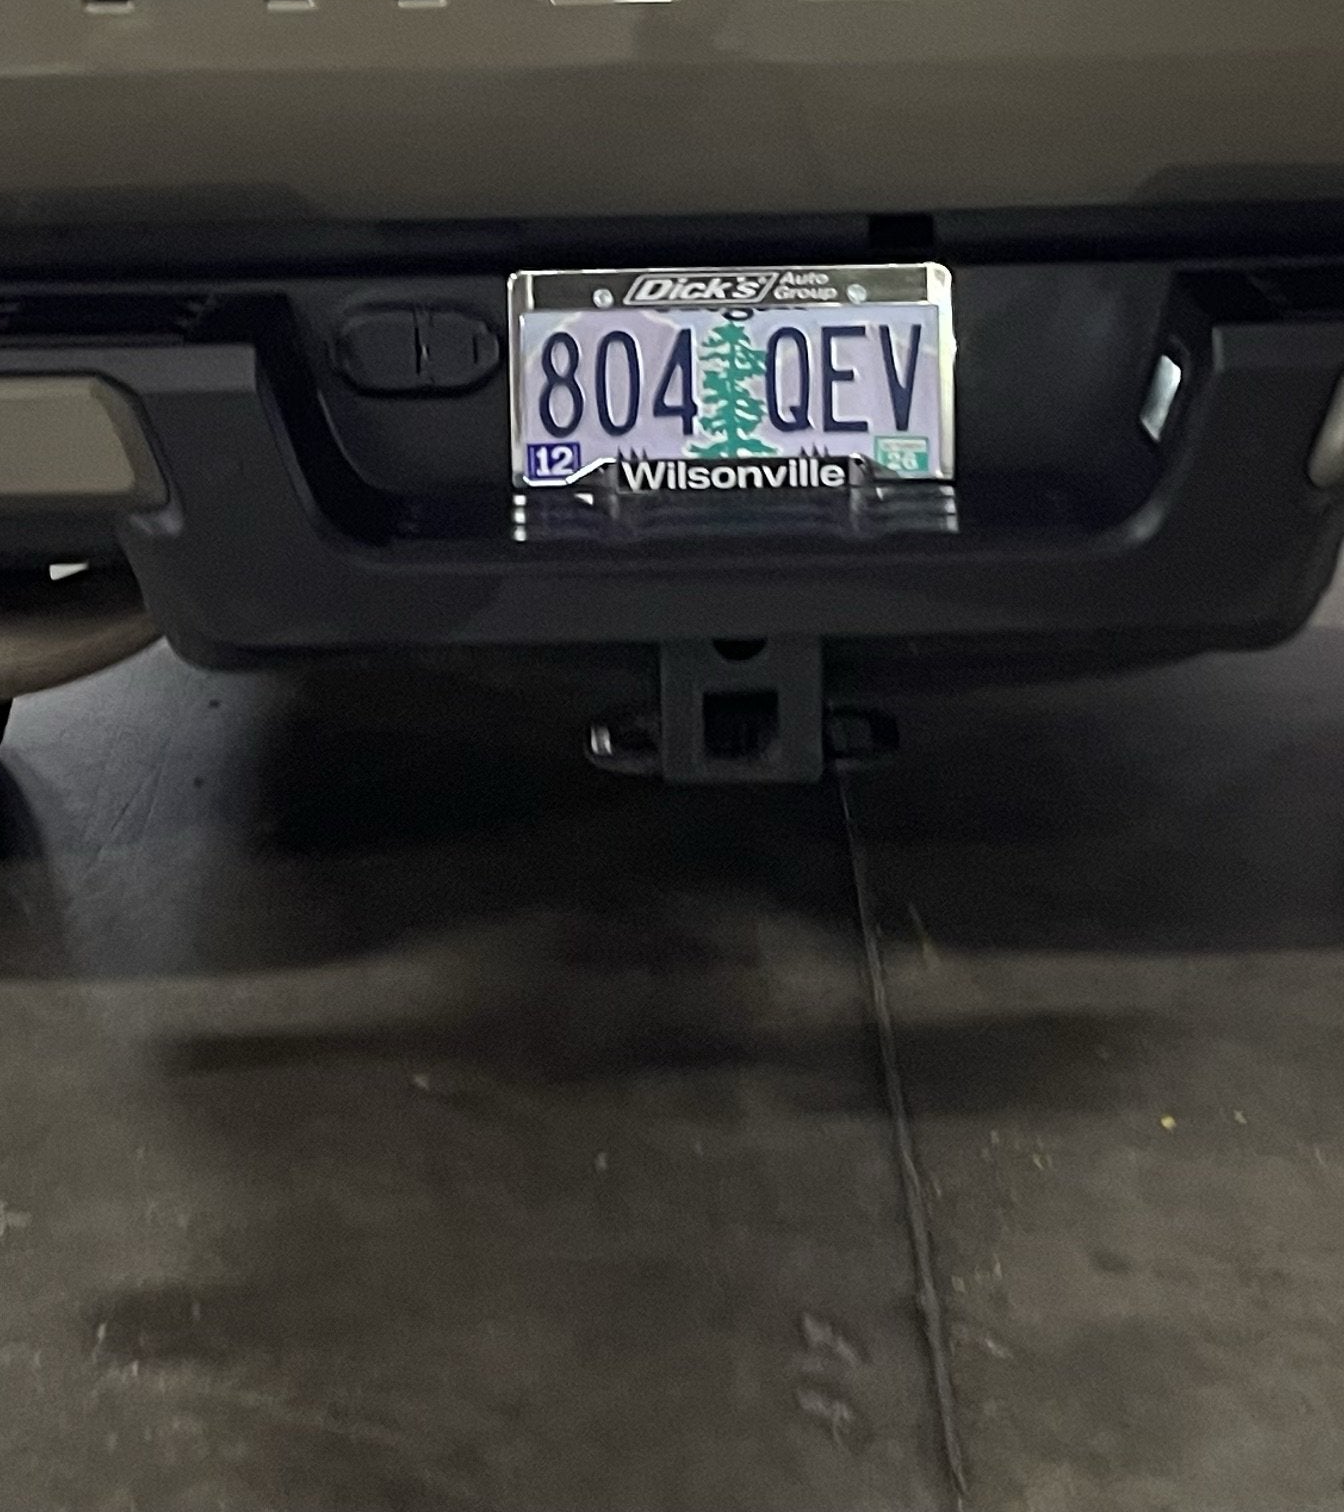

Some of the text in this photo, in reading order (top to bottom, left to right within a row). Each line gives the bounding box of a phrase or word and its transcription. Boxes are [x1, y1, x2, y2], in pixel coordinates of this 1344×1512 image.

[634, 277, 760, 301] Dick's
[778, 272, 829, 285] Auto
[773, 286, 838, 301] Group
[538, 324, 922, 438] 804 QEV
[536, 445, 574, 477] 12
[622, 457, 845, 491] Wilsonville
